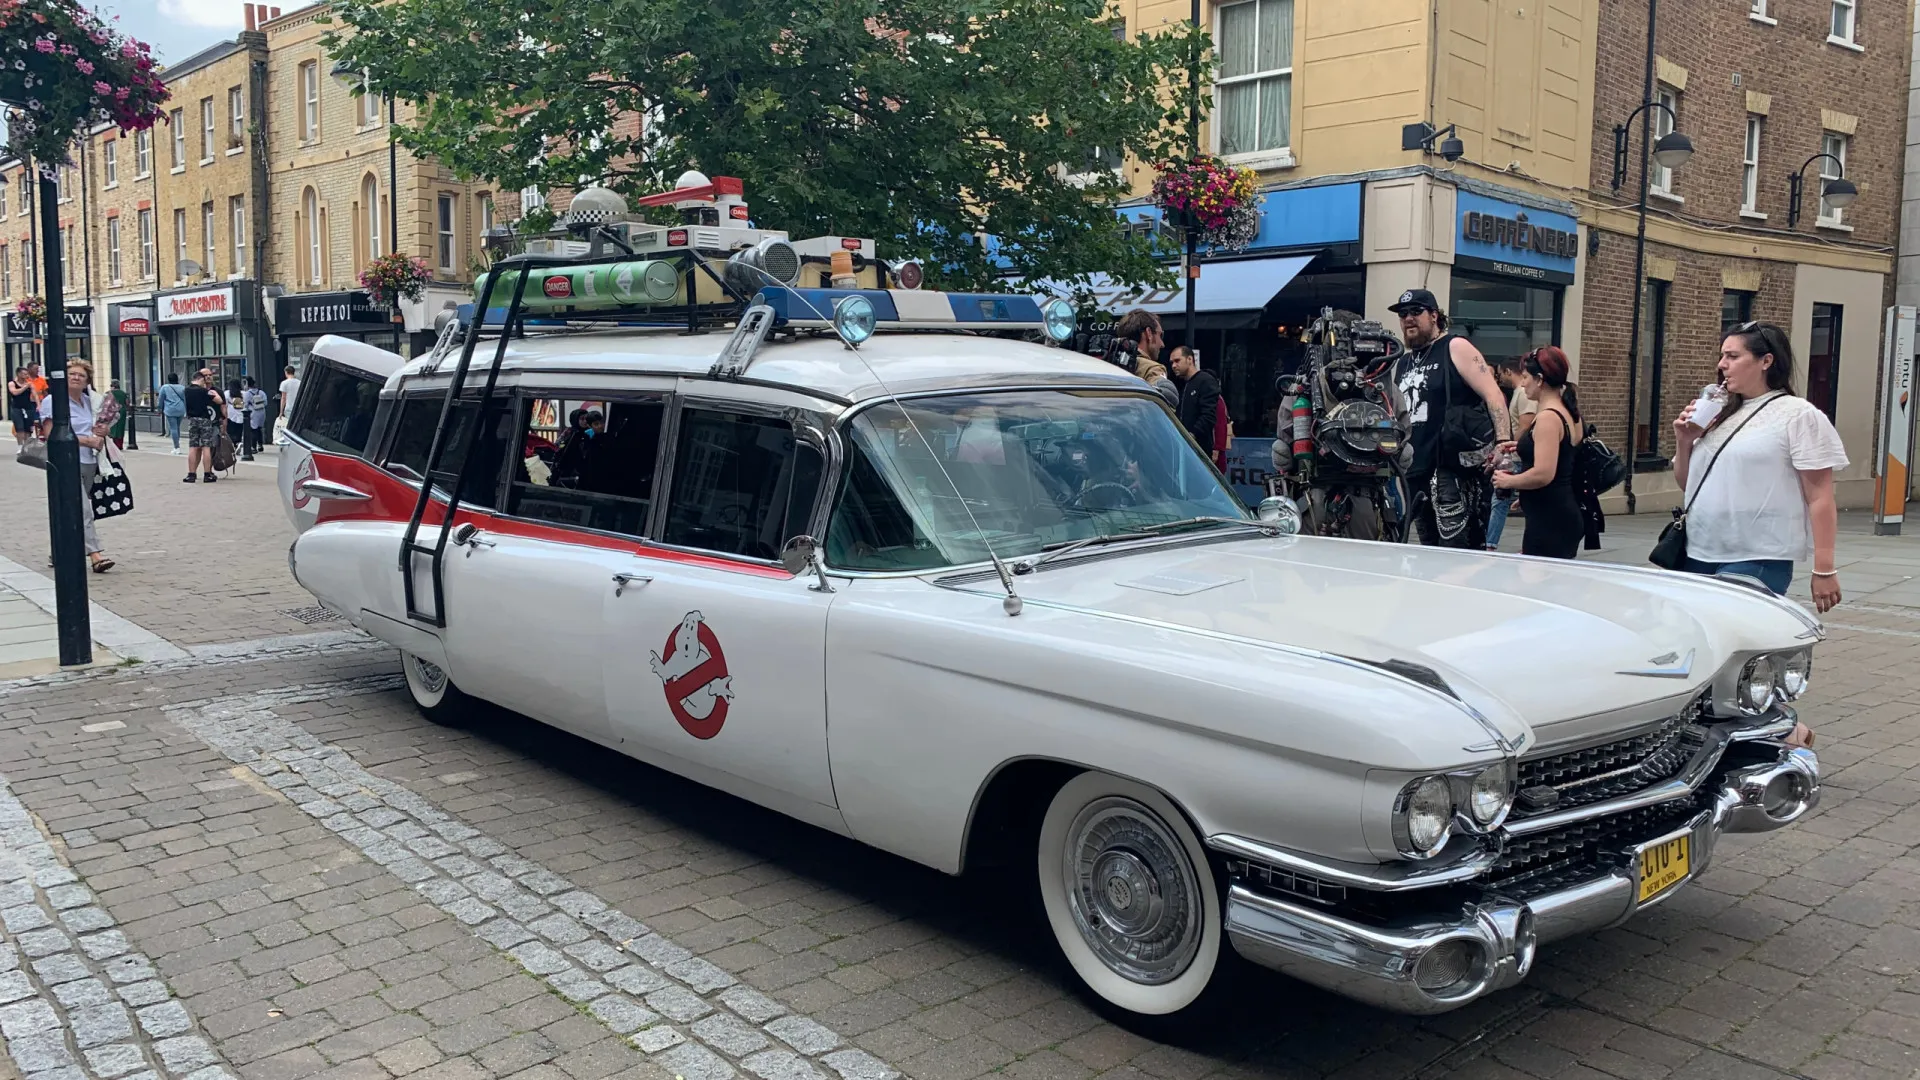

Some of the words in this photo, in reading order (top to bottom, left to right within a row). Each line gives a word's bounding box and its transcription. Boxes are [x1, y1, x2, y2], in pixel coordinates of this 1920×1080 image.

[1463, 210, 1529, 250] CAFFÈ
[1528, 224, 1579, 259] NERO
[1493, 262, 1503, 271] THE
[1503, 264, 1521, 275] ITALIAN
[1521, 267, 1538, 278] COFFEE
[546, 281, 570, 292] DANGER
[300, 304, 351, 323] REPERTOI
[1090, 322, 1120, 331] COFF
[1895, 337, 1905, 389] Uxbridge
[1901, 358, 1912, 388] intu
[1230, 467, 1266, 486] RO
[1646, 879, 1660, 895] NEW
[1661, 871, 1677, 886] YORK
